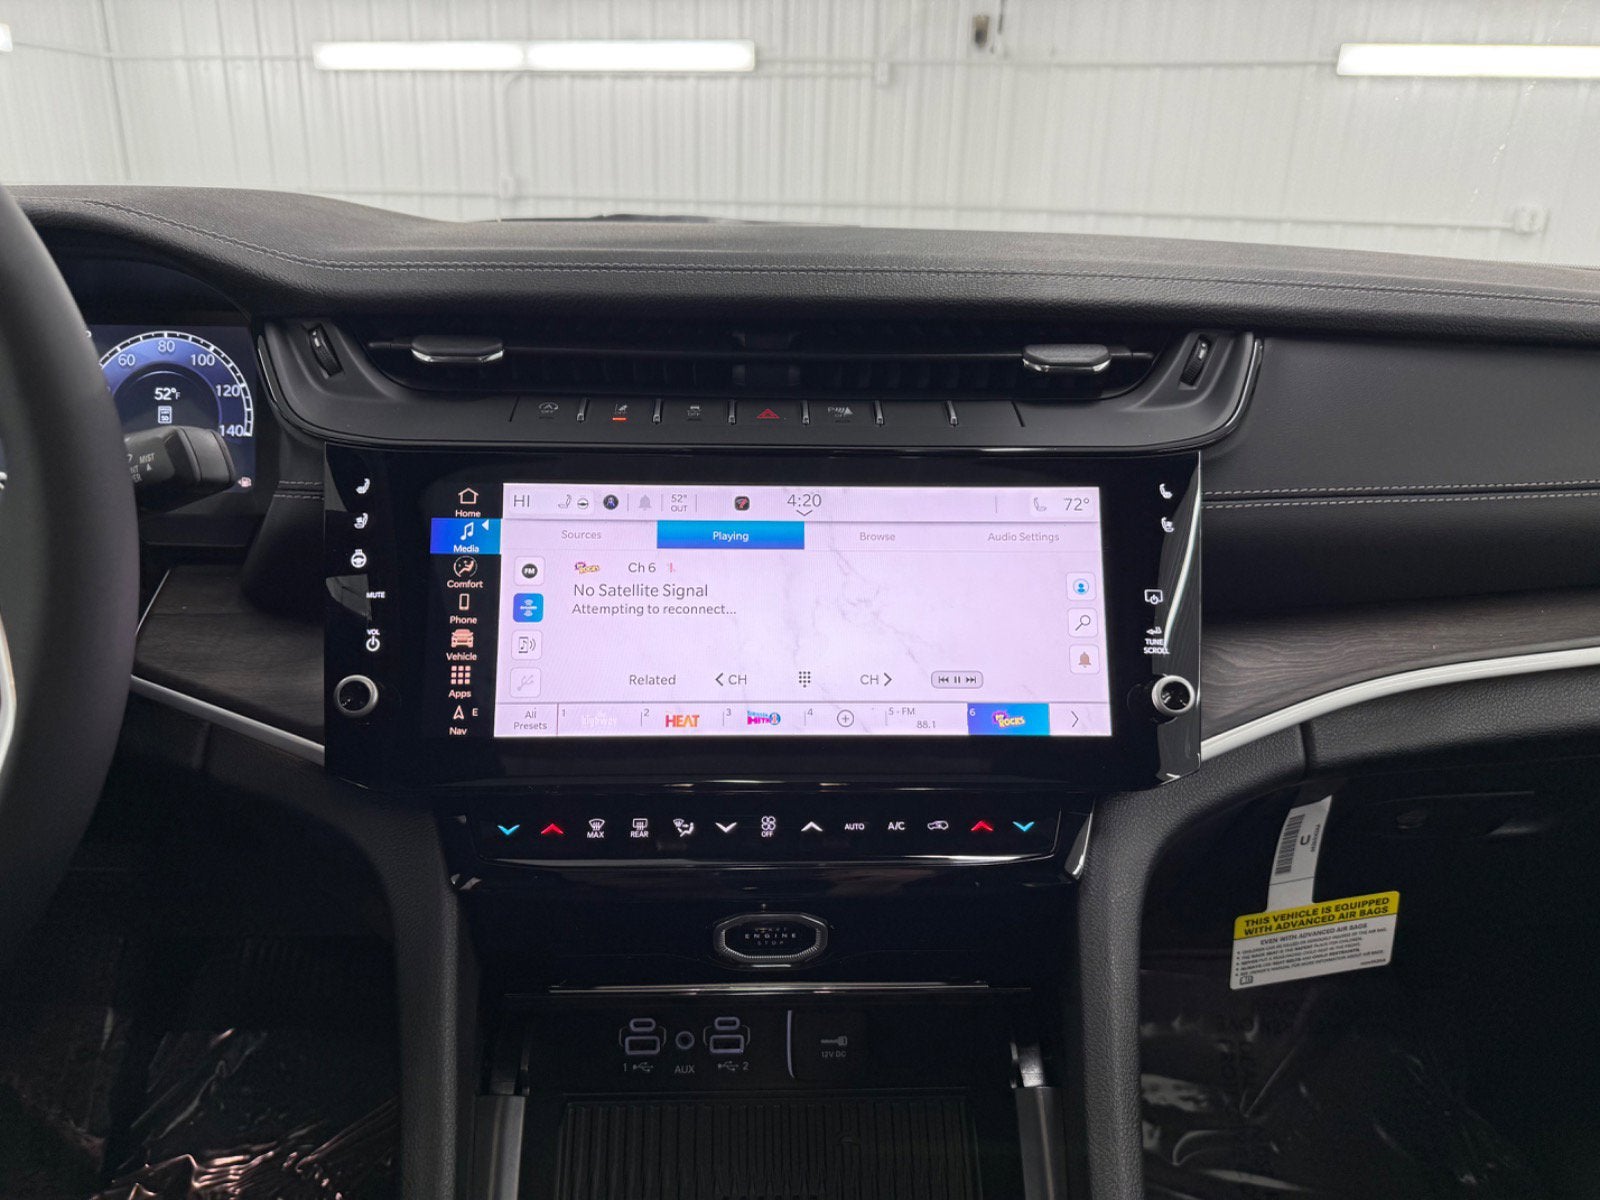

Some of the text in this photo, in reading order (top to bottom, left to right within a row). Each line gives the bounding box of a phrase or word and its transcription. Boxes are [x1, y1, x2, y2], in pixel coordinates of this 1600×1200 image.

[158, 341, 175, 353] 80
[118, 354, 136, 366] 60
[190, 354, 215, 366] 100
[216, 385, 240, 398] 120
[219, 425, 244, 437] 140
[513, 494, 531, 508] HI
[787, 493, 823, 508] 4:20
[1063, 497, 1090, 512] 72°
[455, 510, 481, 518] Home
[561, 530, 602, 540] Sources
[712, 530, 750, 542] Playing
[859, 532, 896, 542] Browse
[987, 532, 1060, 543] Audio Settings
[453, 544, 480, 553] Media
[628, 562, 656, 573] Ch 6
[447, 579, 483, 588] Comfort
[366, 591, 386, 599] MUTE
[573, 583, 708, 600] No Satellite Signal
[572, 603, 737, 616] Attempting to reconnect...
[450, 615, 477, 624] Phone
[366, 628, 381, 636] VOL
[1144, 637, 1165, 646] TUNE
[1143, 646, 1171, 655] SCROLL
[446, 652, 477, 661] Vehicle
[629, 674, 677, 686] Related
[728, 674, 747, 685] CH
[860, 674, 879, 685] CH
[448, 689, 472, 700] Apps
[472, 708, 479, 717] E
[525, 710, 537, 719] All
[562, 709, 567, 717] 1
[643, 708, 650, 717] 2
[725, 708, 732, 717] 3
[807, 708, 814, 717] 4
[888, 707, 894, 716] 5
[901, 708, 915, 716] FM
[969, 707, 976, 717] 6
[513, 721, 548, 731] Presets
[665, 714, 700, 728] HEAT
[916, 720, 937, 729] 88.1
[449, 727, 468, 736] Nav
[887, 821, 906, 831] A/C
[587, 831, 605, 839] MAX
[630, 830, 649, 838] REAR
[1244, 897, 1390, 928] THIS VEHICLE IS EQUIPPED
[1244, 906, 1389, 936] WITH ADVANCED AIR BAGS
[1280, 934, 1297, 943] WITH
[1299, 929, 1336, 940] ADVANCED
[623, 1062, 627, 1072] 1
[674, 1065, 695, 1074] AUX
[742, 1061, 749, 1071] 2
